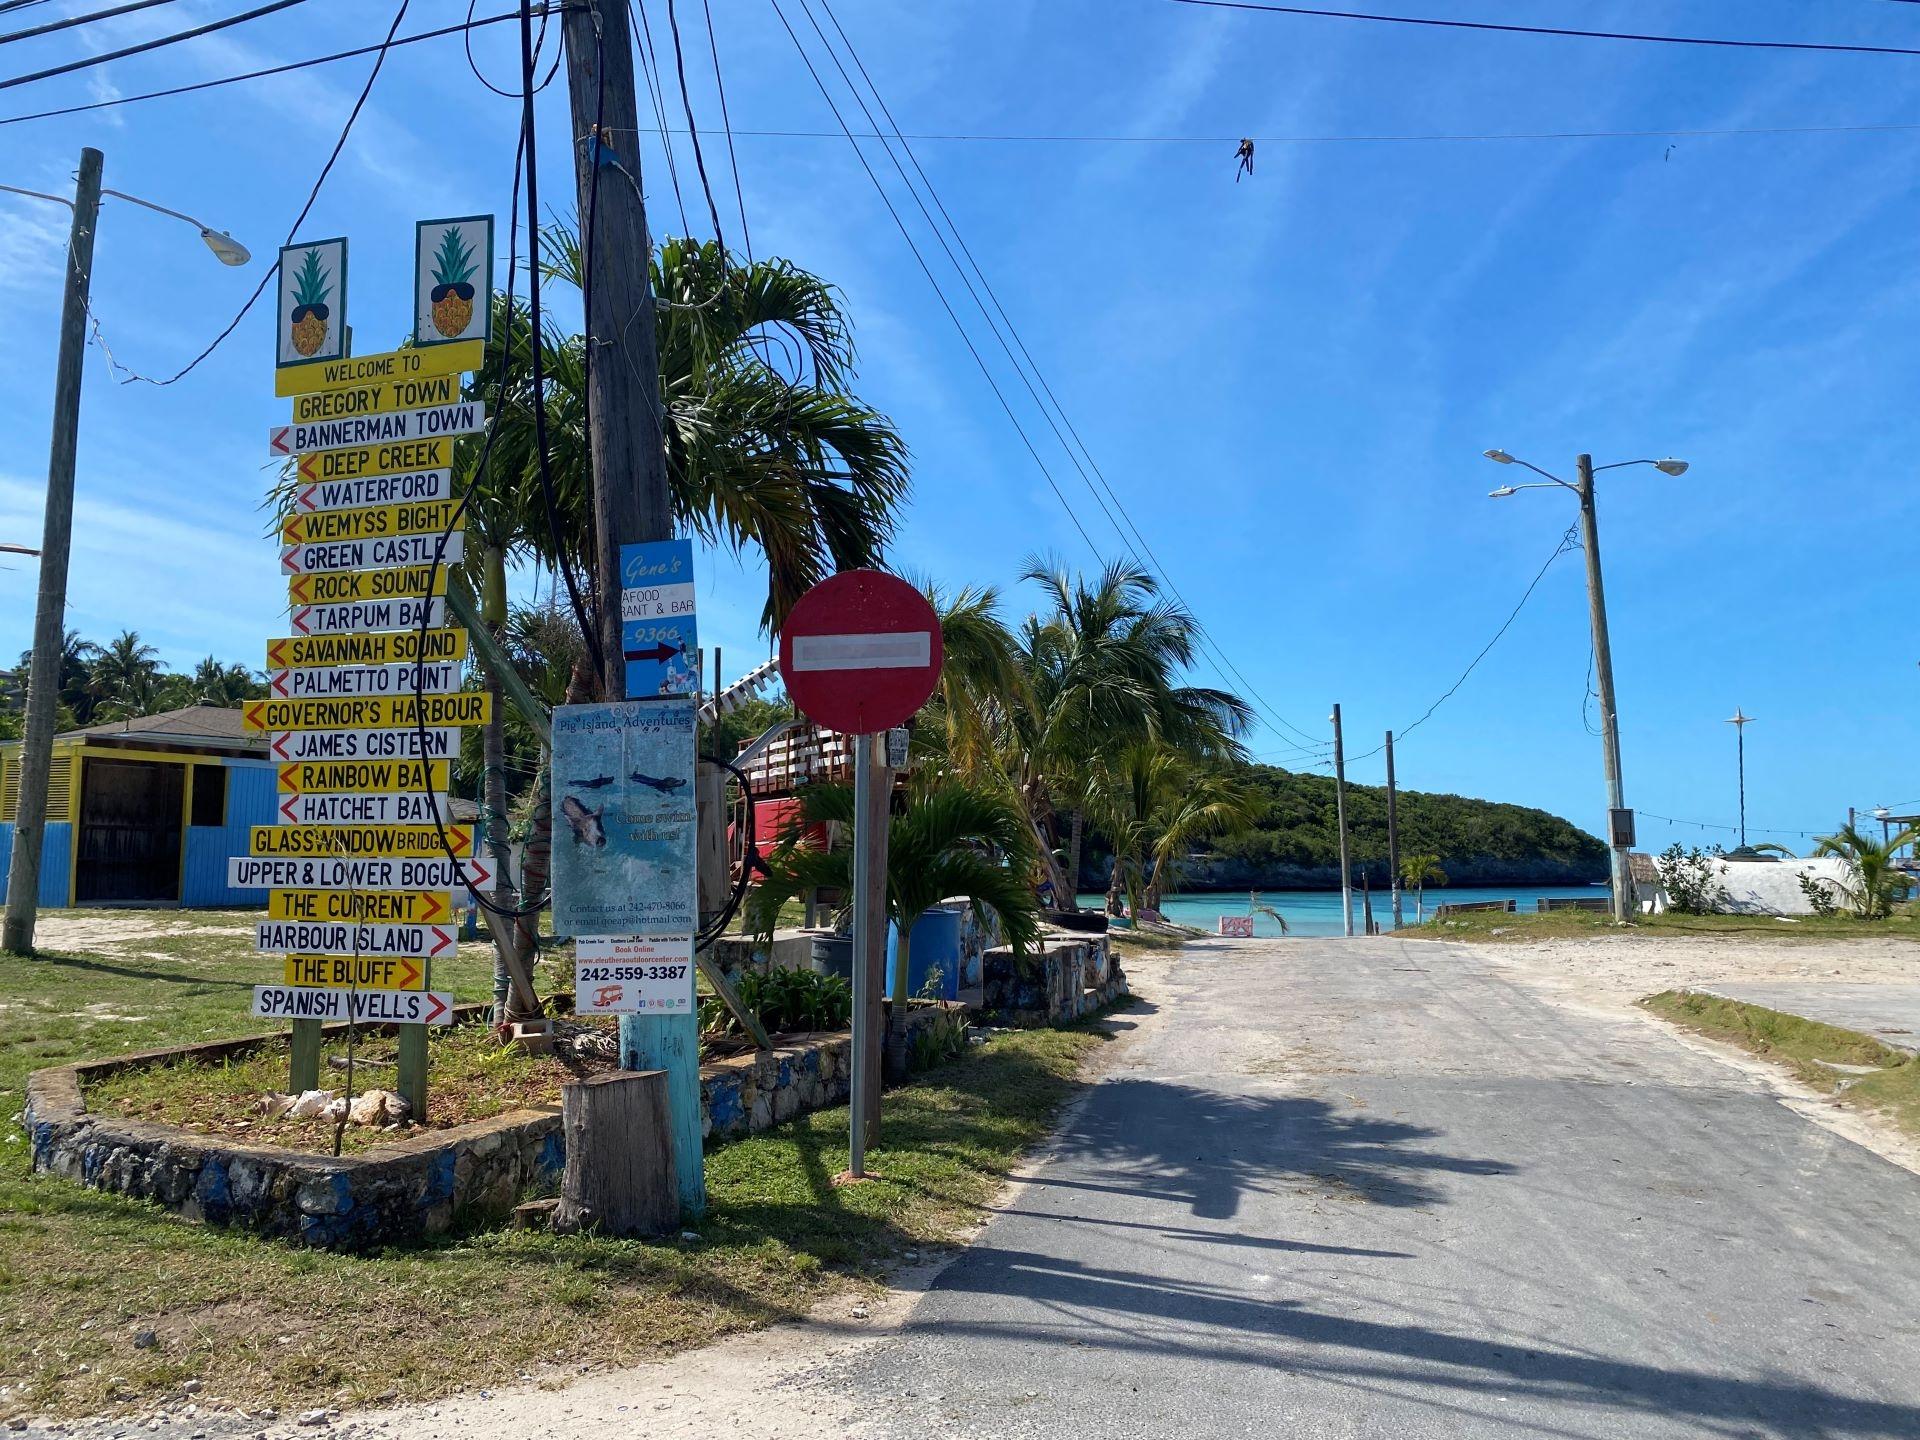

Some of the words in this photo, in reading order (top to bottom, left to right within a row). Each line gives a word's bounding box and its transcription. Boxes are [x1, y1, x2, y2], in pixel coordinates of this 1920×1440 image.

[324, 358, 394, 383] WELCOME
[403, 355, 420, 371] TO
[300, 388, 381, 419] GREGORY
[394, 378, 450, 404] TOWN
[295, 414, 406, 449] BANNERMAN
[416, 406, 473, 434] TOWN
[323, 449, 369, 476] DEEP
[379, 441, 440, 470] CREEK
[322, 473, 438, 506] WATERFORD
[306, 511, 387, 537] WEMYSS
[397, 504, 452, 531] BIGHT
[304, 543, 363, 570] GREEN
[373, 537, 446, 563] CASTLE
[625, 555, 682, 584] Gene's
[314, 574, 361, 599] ROCK
[372, 569, 432, 595] SOUND
[316, 605, 390, 630] TARPUM
[400, 600, 434, 626] BAY
[656, 603, 664, 614] &
[671, 600, 694, 613] BAR
[622, 625, 680, 643] -9366
[293, 638, 385, 663] SAVANNAH
[393, 632, 455, 657] SOUND
[294, 669, 388, 694] PALMETTO
[397, 666, 452, 691] POINT
[267, 701, 380, 727] GOVERNOR'S
[392, 696, 482, 724] HARBOUR
[560, 720, 577, 733] Pig
[582, 717, 616, 730] Island
[624, 714, 690, 728] Adventures
[295, 733, 357, 757] JAMES
[366, 731, 447, 756] CISTERN
[303, 764, 391, 789] RAINBOW
[400, 763, 435, 787] BAY
[304, 797, 387, 821] HATCHET
[400, 796, 435, 821] BAY
[616, 812, 653, 825] Come
[655, 810, 692, 824] swim
[397, 831, 448, 850] BRIDGE
[629, 828, 658, 841] with
[238, 861, 297, 885] UPPER
[302, 862, 314, 885] &
[321, 862, 392, 885] LOWER
[401, 862, 466, 886] BOGUE
[283, 893, 317, 917] THE
[328, 894, 416, 918] CURRENT
[569, 903, 604, 914] Contact
[606, 904, 616, 913] us
[618, 903, 626, 912] at
[563, 918, 573, 926] or
[575, 915, 599, 926] email
[260, 925, 346, 950] HARBOUR
[353, 927, 423, 952] ISLAND
[633, 945, 655, 953] Online
[292, 958, 329, 982] THE
[333, 959, 396, 984] BLUFF
[581, 965, 687, 981] 242-559-3387
[260, 990, 338, 1016] SPANISH
